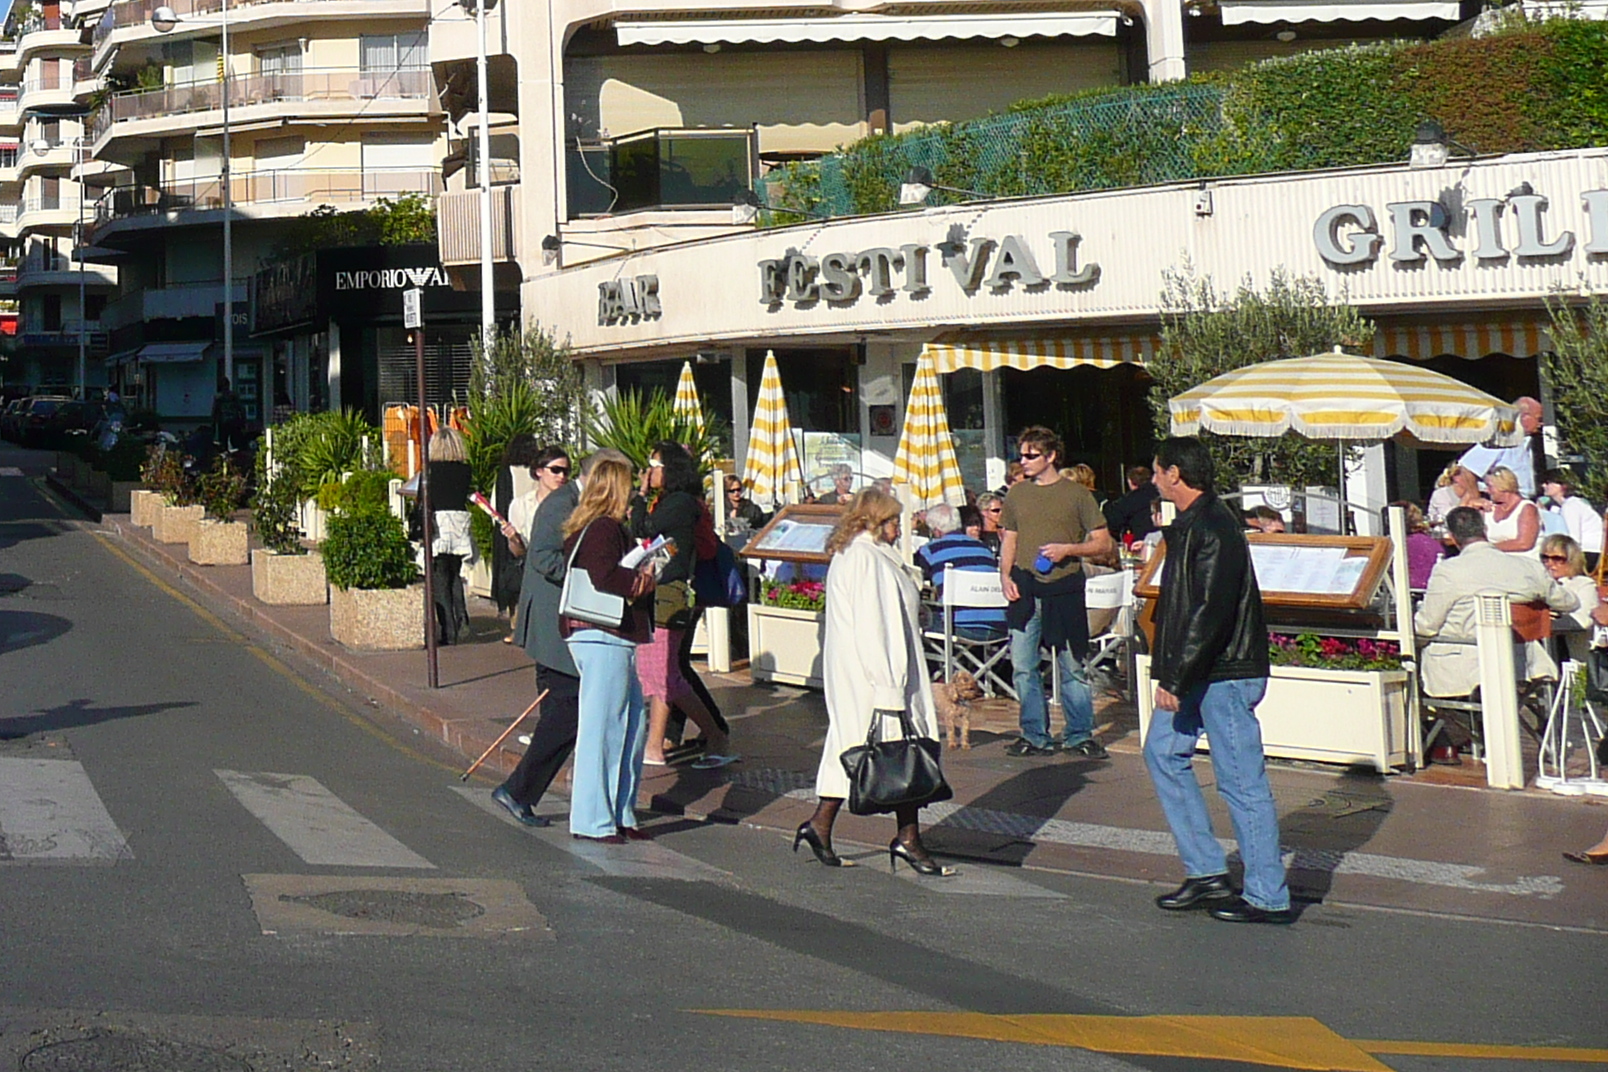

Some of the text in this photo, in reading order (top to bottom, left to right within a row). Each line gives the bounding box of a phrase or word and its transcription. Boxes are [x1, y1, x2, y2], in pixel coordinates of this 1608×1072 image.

[335, 269, 406, 290] EMPORIO
[758, 231, 1101, 305] FESTIVAL
[598, 275, 662, 322] BAR
[230, 313, 248, 326] OIS
